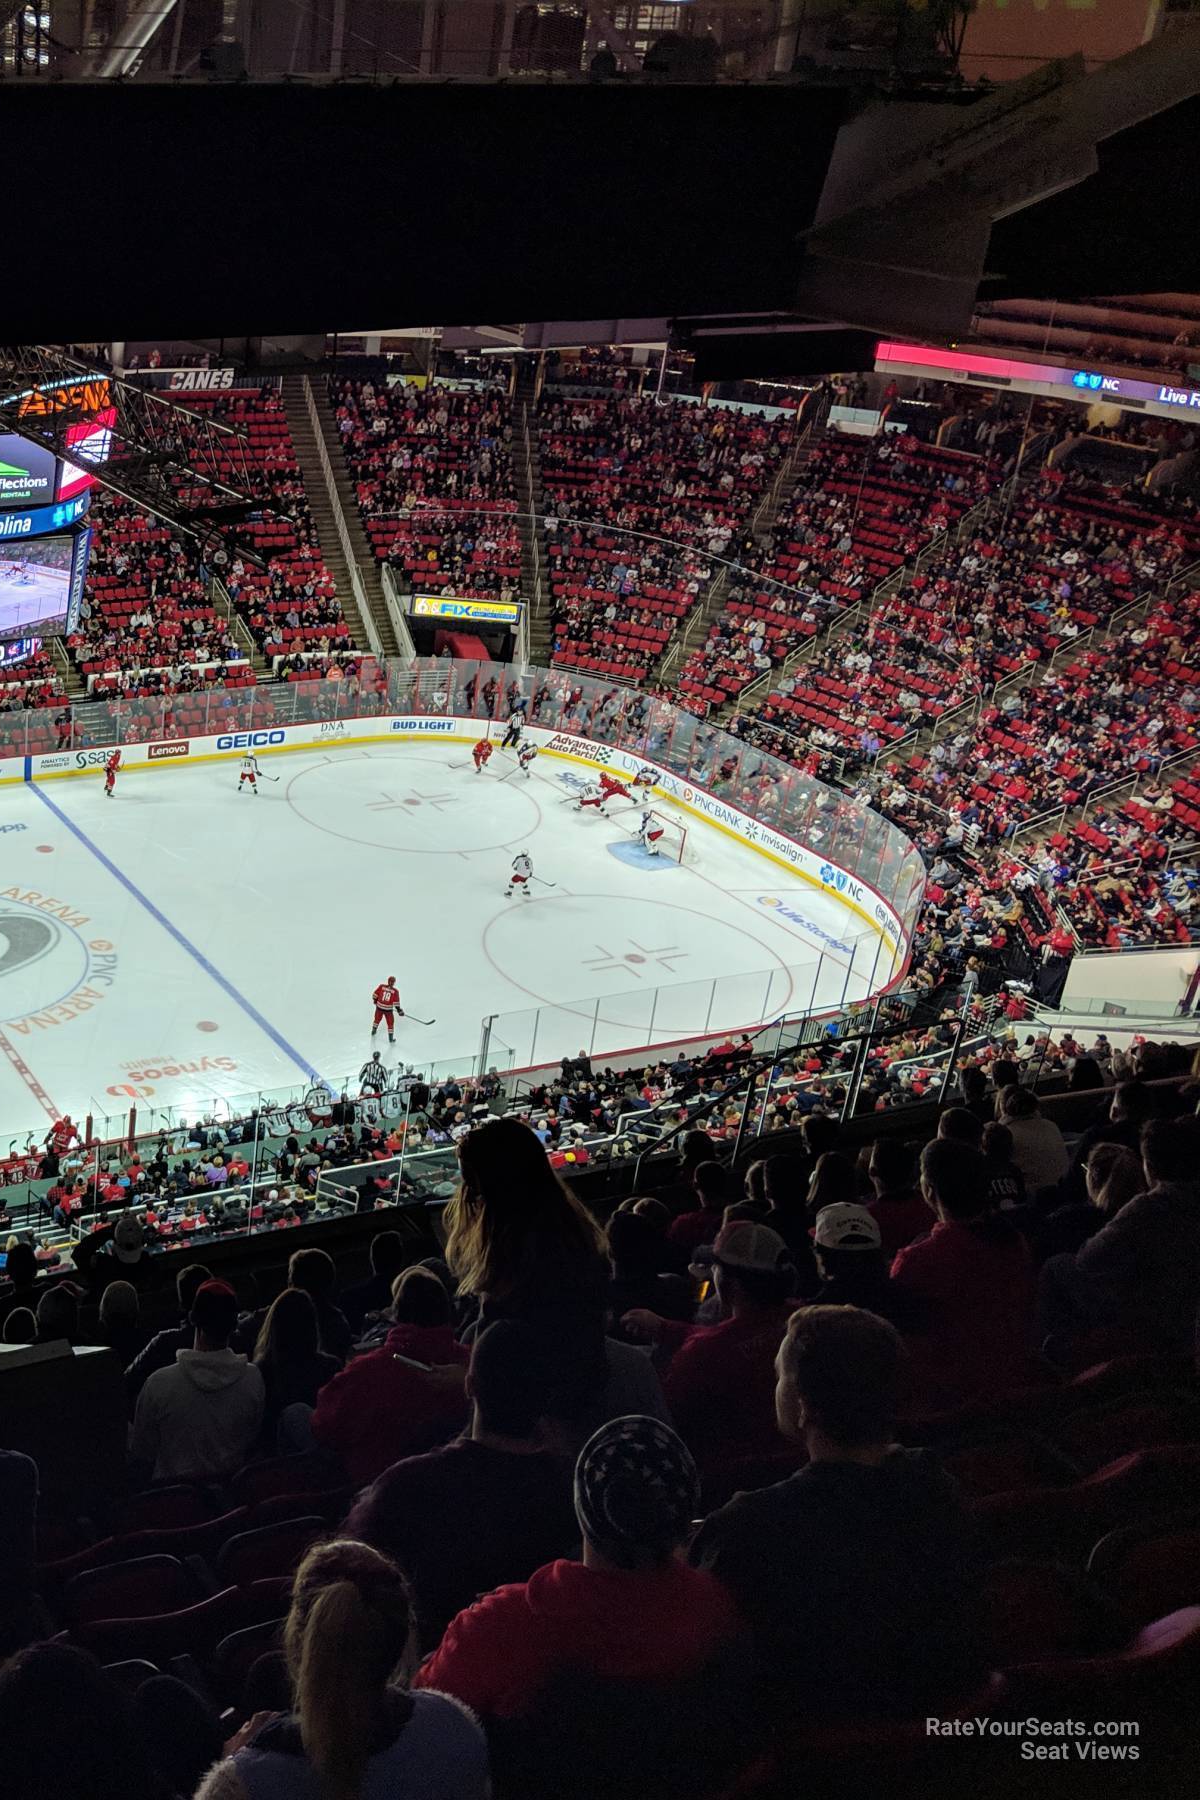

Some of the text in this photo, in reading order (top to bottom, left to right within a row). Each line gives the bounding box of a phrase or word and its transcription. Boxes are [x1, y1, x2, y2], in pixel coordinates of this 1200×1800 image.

[170, 371, 234, 390] CANES
[1102, 378, 1120, 390] NC
[1160, 387, 1187, 404] Live
[74, 499, 84, 515] NC
[440, 604, 472, 616] FIX
[320, 720, 345, 732] DNA
[392, 720, 454, 731] BUD LIGHT
[216, 730, 286, 750] GEICO
[553, 734, 598, 753] Advance
[151, 744, 186, 757] Lenovo
[544, 742, 596, 760] Auto Parts
[760, 831, 804, 863] invisalign
[848, 882, 864, 902] NC
[0, 886, 91, 928] ARENA
[95, 954, 118, 987] PNC
[5, 986, 106, 1034] ARENA
[128, 1056, 238, 1082] Syneos
